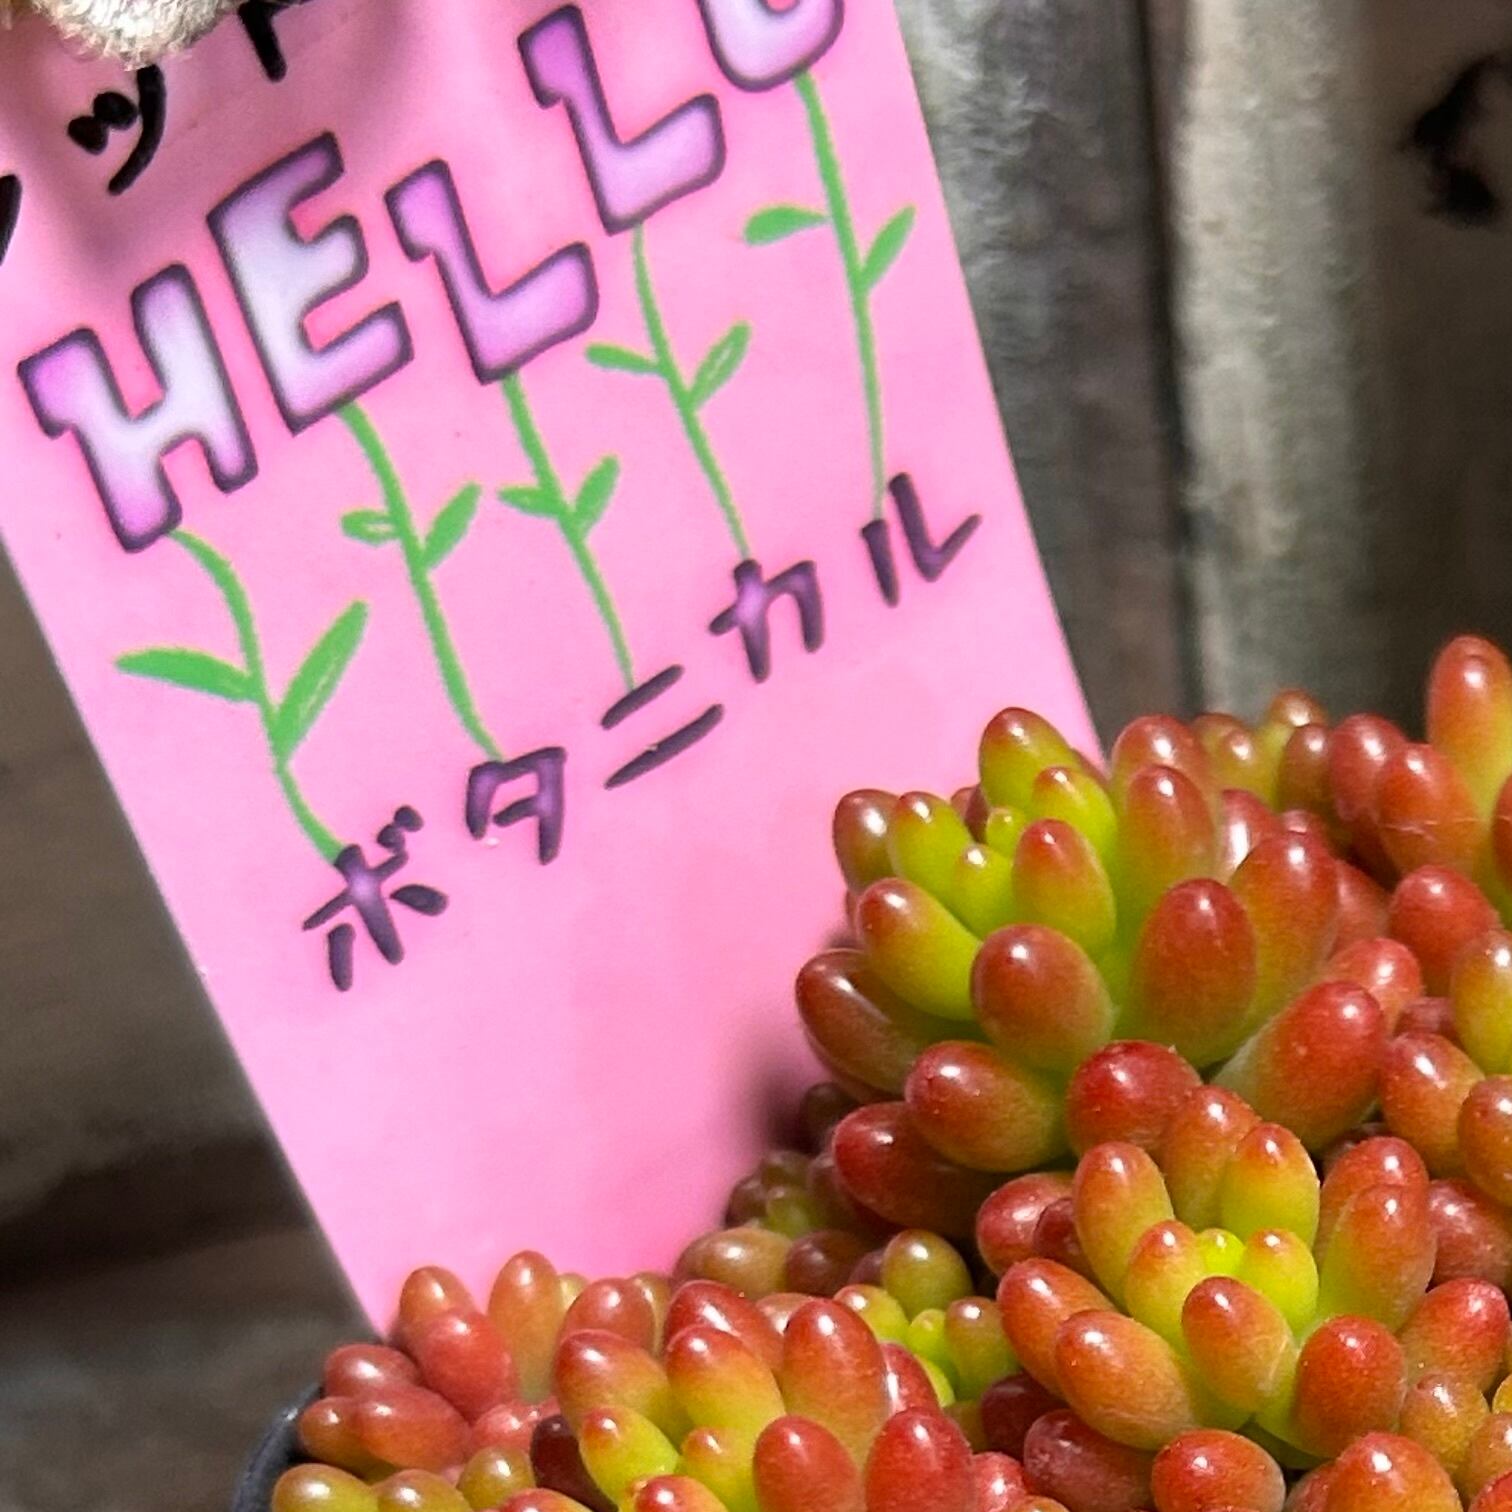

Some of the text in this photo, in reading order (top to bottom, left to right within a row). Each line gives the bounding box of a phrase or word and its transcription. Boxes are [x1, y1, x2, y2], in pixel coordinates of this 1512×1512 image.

[301, 471, 982, 991] ボタニカル
